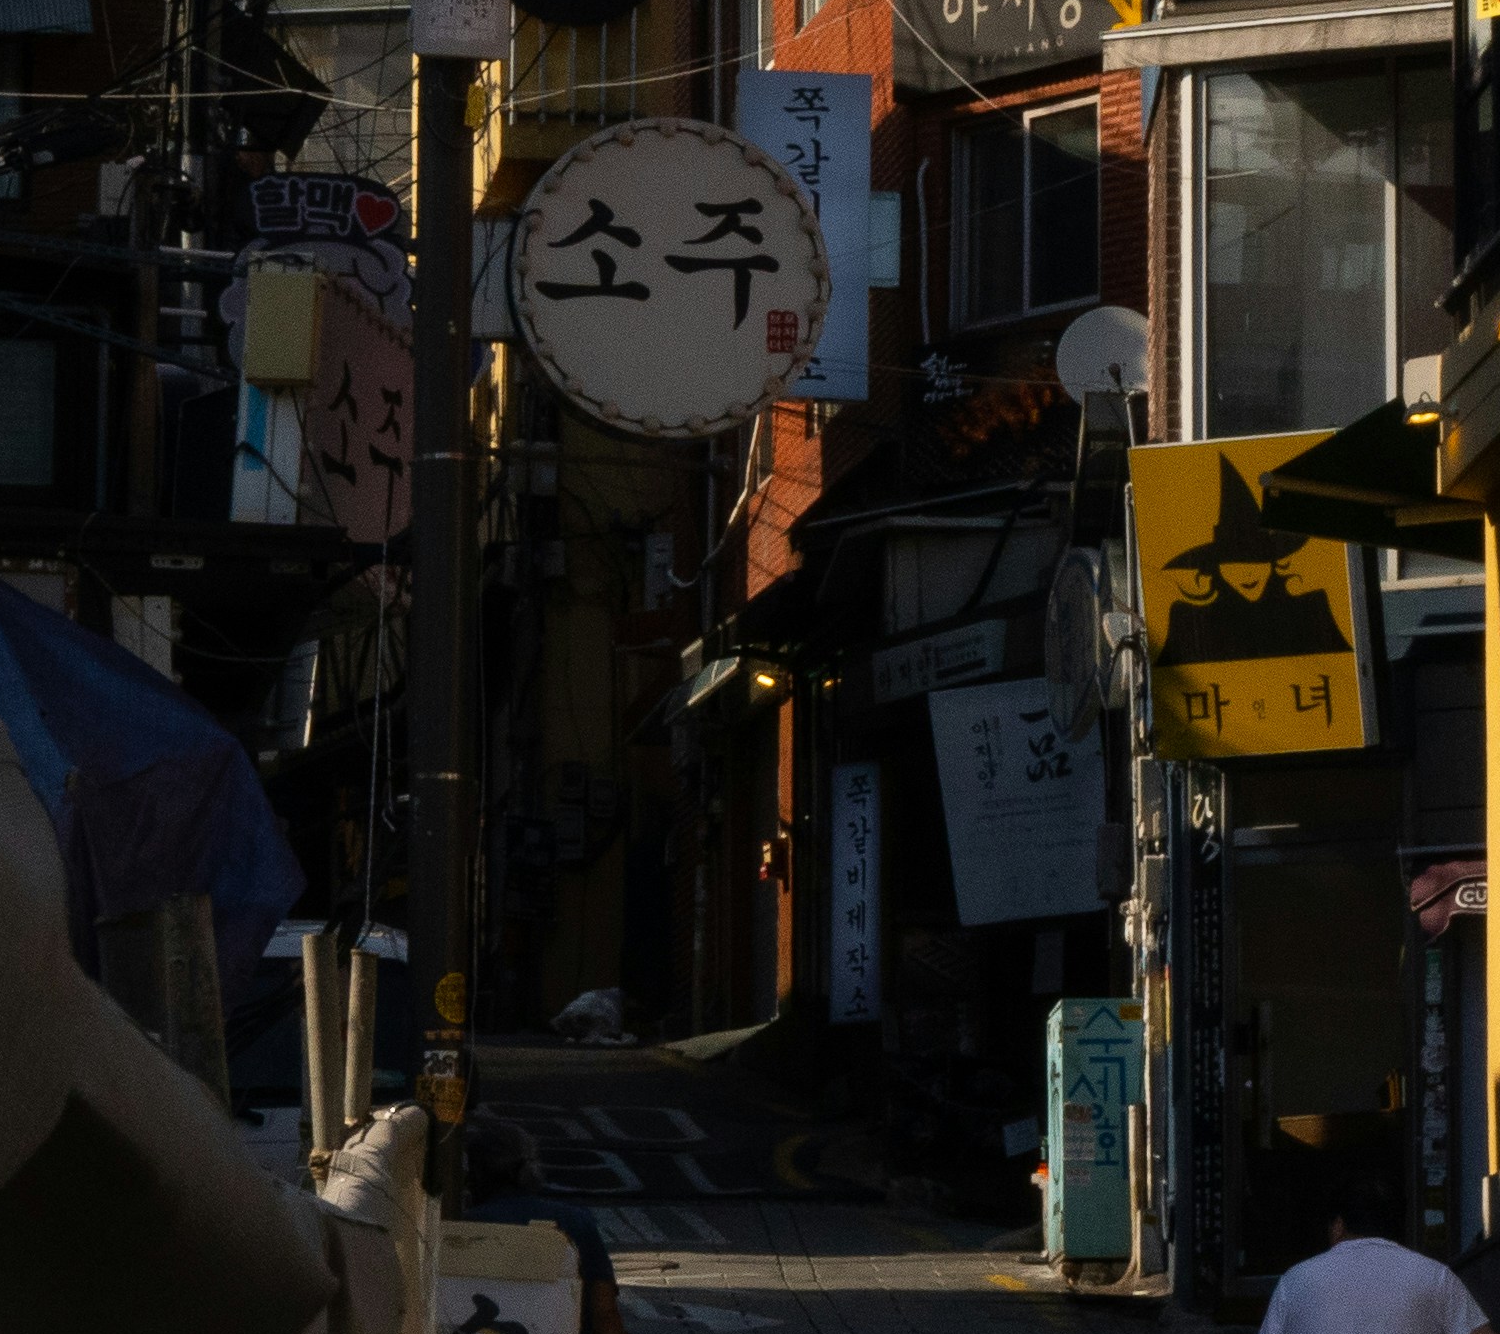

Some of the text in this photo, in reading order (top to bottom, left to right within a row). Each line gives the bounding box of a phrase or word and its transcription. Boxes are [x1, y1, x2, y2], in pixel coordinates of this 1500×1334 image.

[250, 176, 356, 237] 할맥
[534, 198, 781, 331] 소주
[319, 360, 404, 537] 소주
[845, 772, 872, 1018] 쪽갈비제작소
